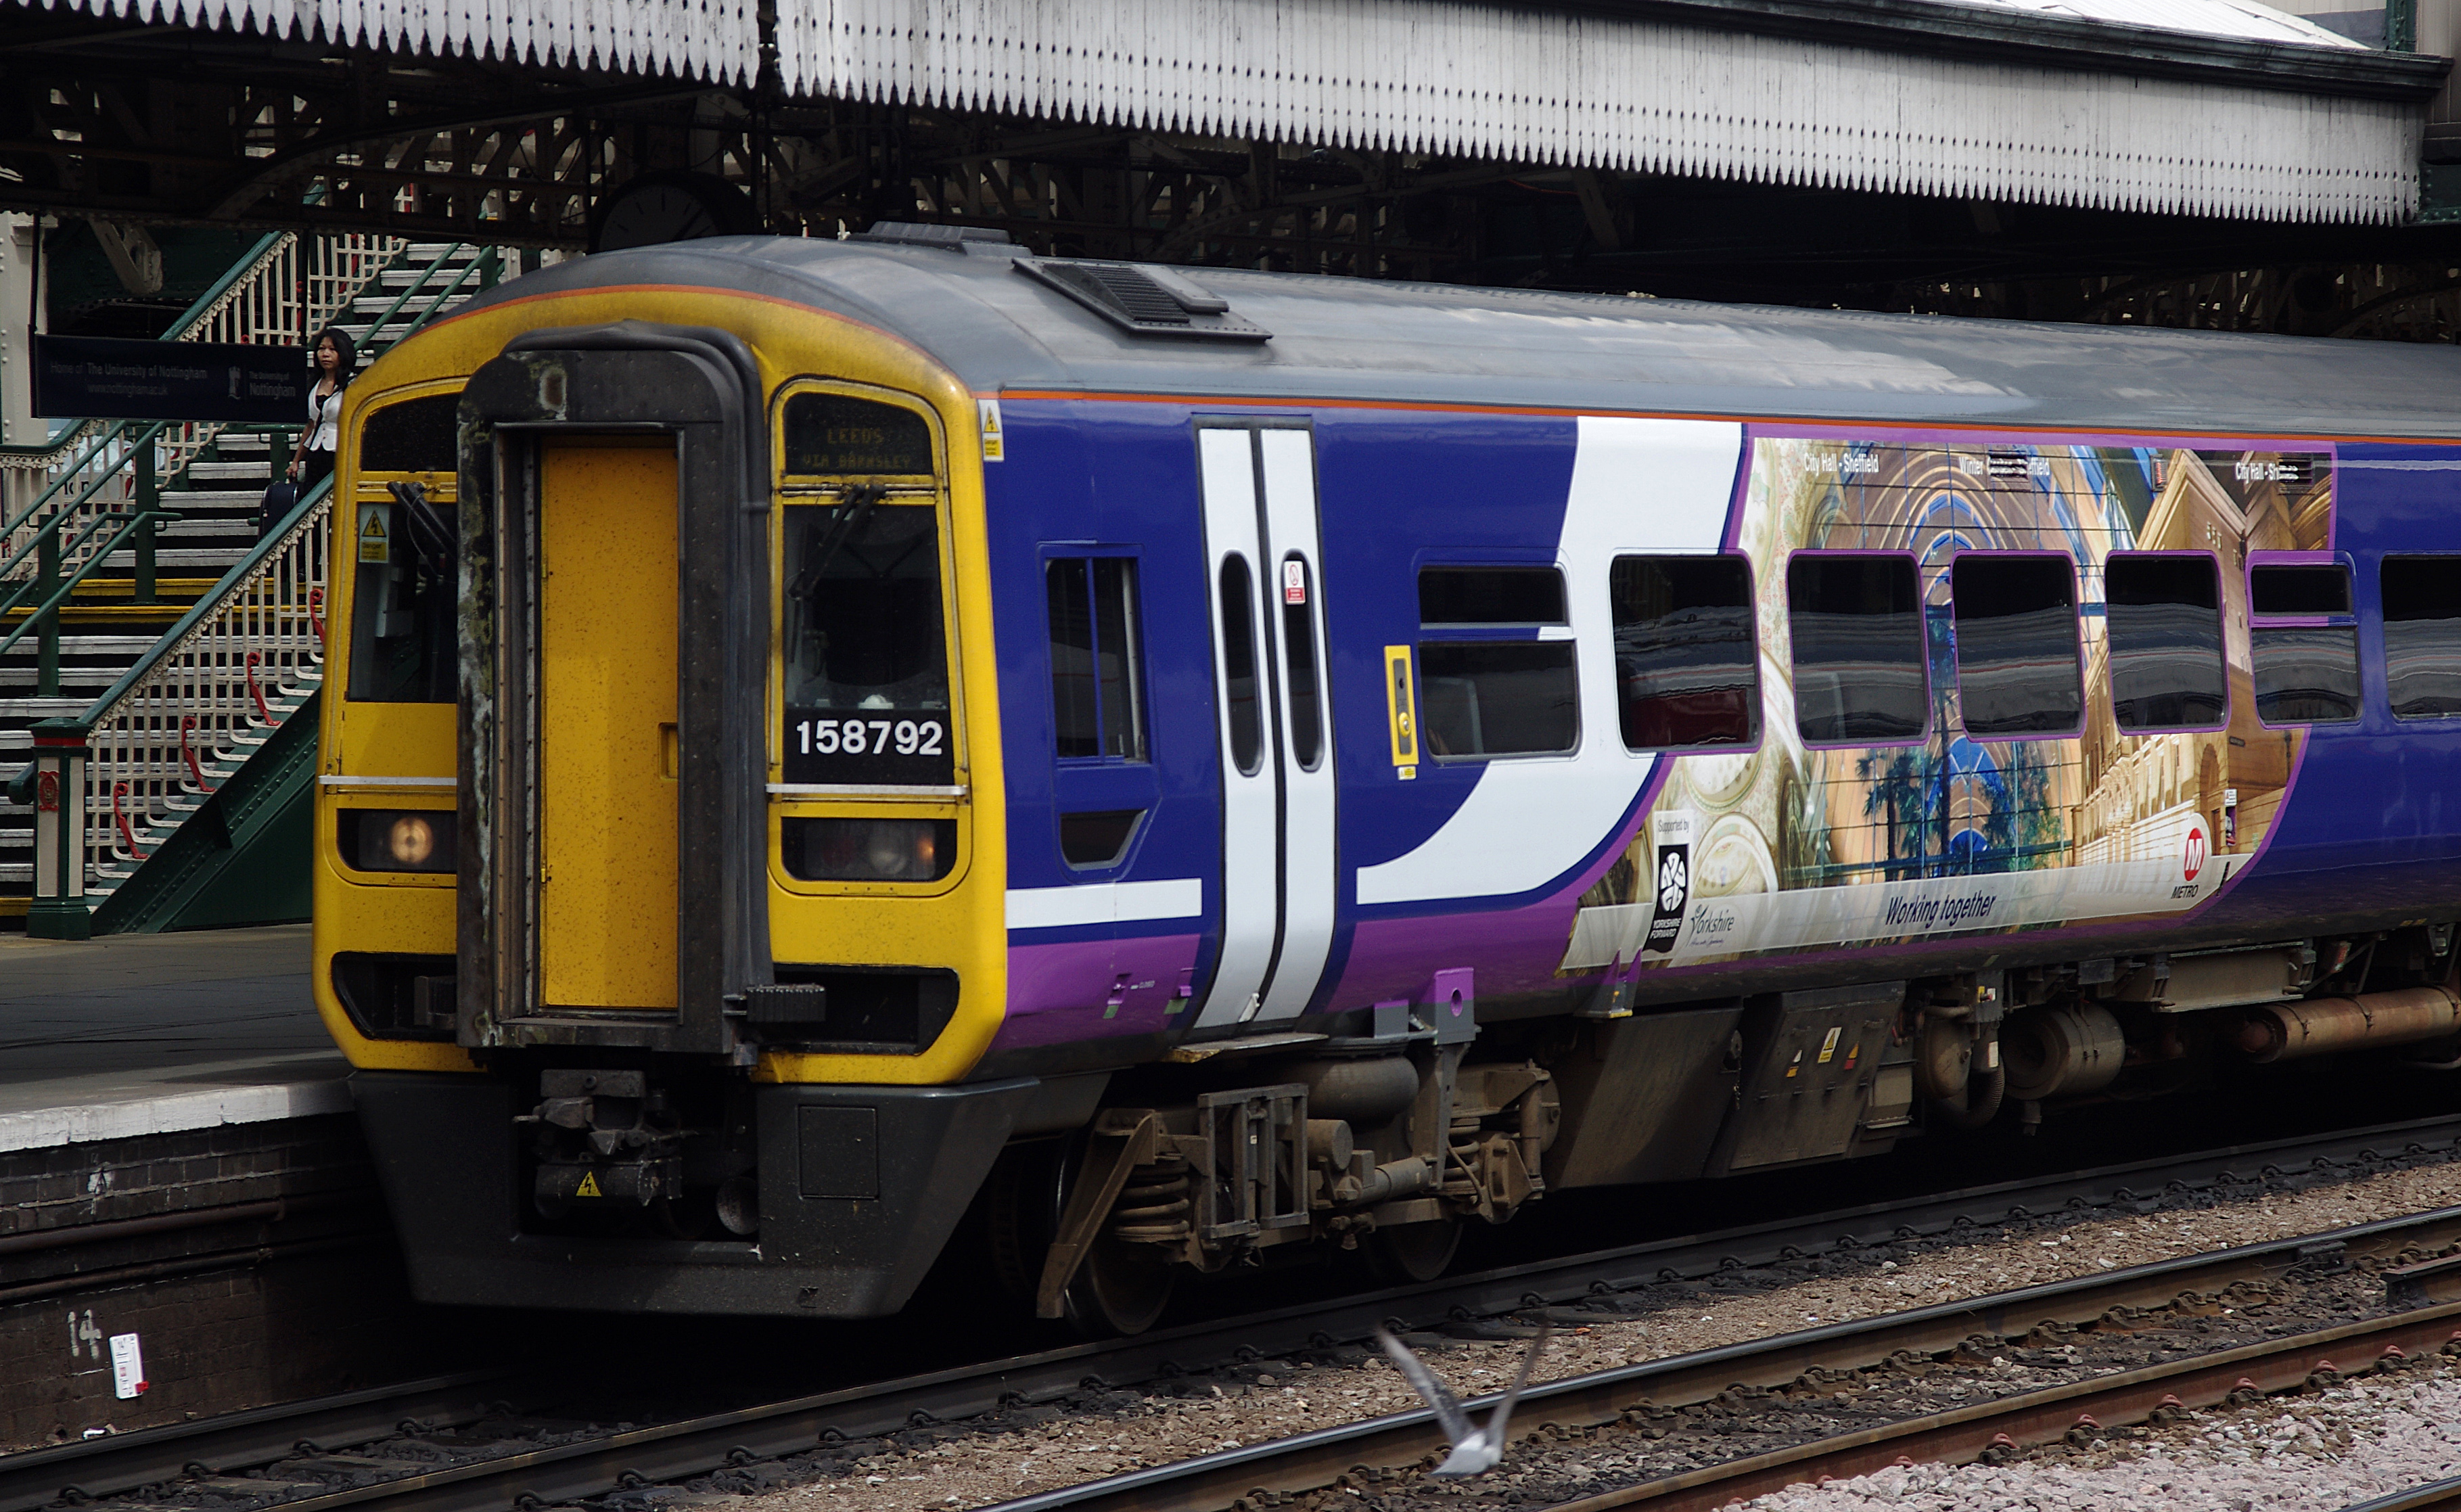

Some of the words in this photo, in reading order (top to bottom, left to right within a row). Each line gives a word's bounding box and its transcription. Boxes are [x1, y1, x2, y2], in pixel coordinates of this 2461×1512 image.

[87, 363, 103, 374] The
[104, 363, 147, 378] University
[147, 365, 157, 376] of
[159, 365, 208, 380] Nottingham
[250, 382, 296, 400] Nottingham
[827, 428, 885, 444] LEEDS
[803, 454, 830, 468] VIA
[839, 454, 911, 469] BARNSLEY
[1803, 452, 1820, 476] City
[1821, 453, 1837, 472] Hall
[1843, 453, 1879, 474] Sheffield
[1959, 457, 1983, 475] Winter
[2236, 461, 2250, 484] City
[2250, 463, 2265, 480] Hall
[796, 720, 944, 756] 158792
[1658, 819, 1682, 834] Supported
[1683, 818, 1690, 833] by
[2171, 884, 2199, 899] METRO
[1885, 894, 1939, 929] Working
[1939, 890, 1997, 927] together
[1653, 918, 1682, 929] YORKSHIRE
[1688, 904, 1734, 941] Yorkshire
[1651, 929, 1677, 939] FORWARD
[68, 1309, 102, 1360] 14
